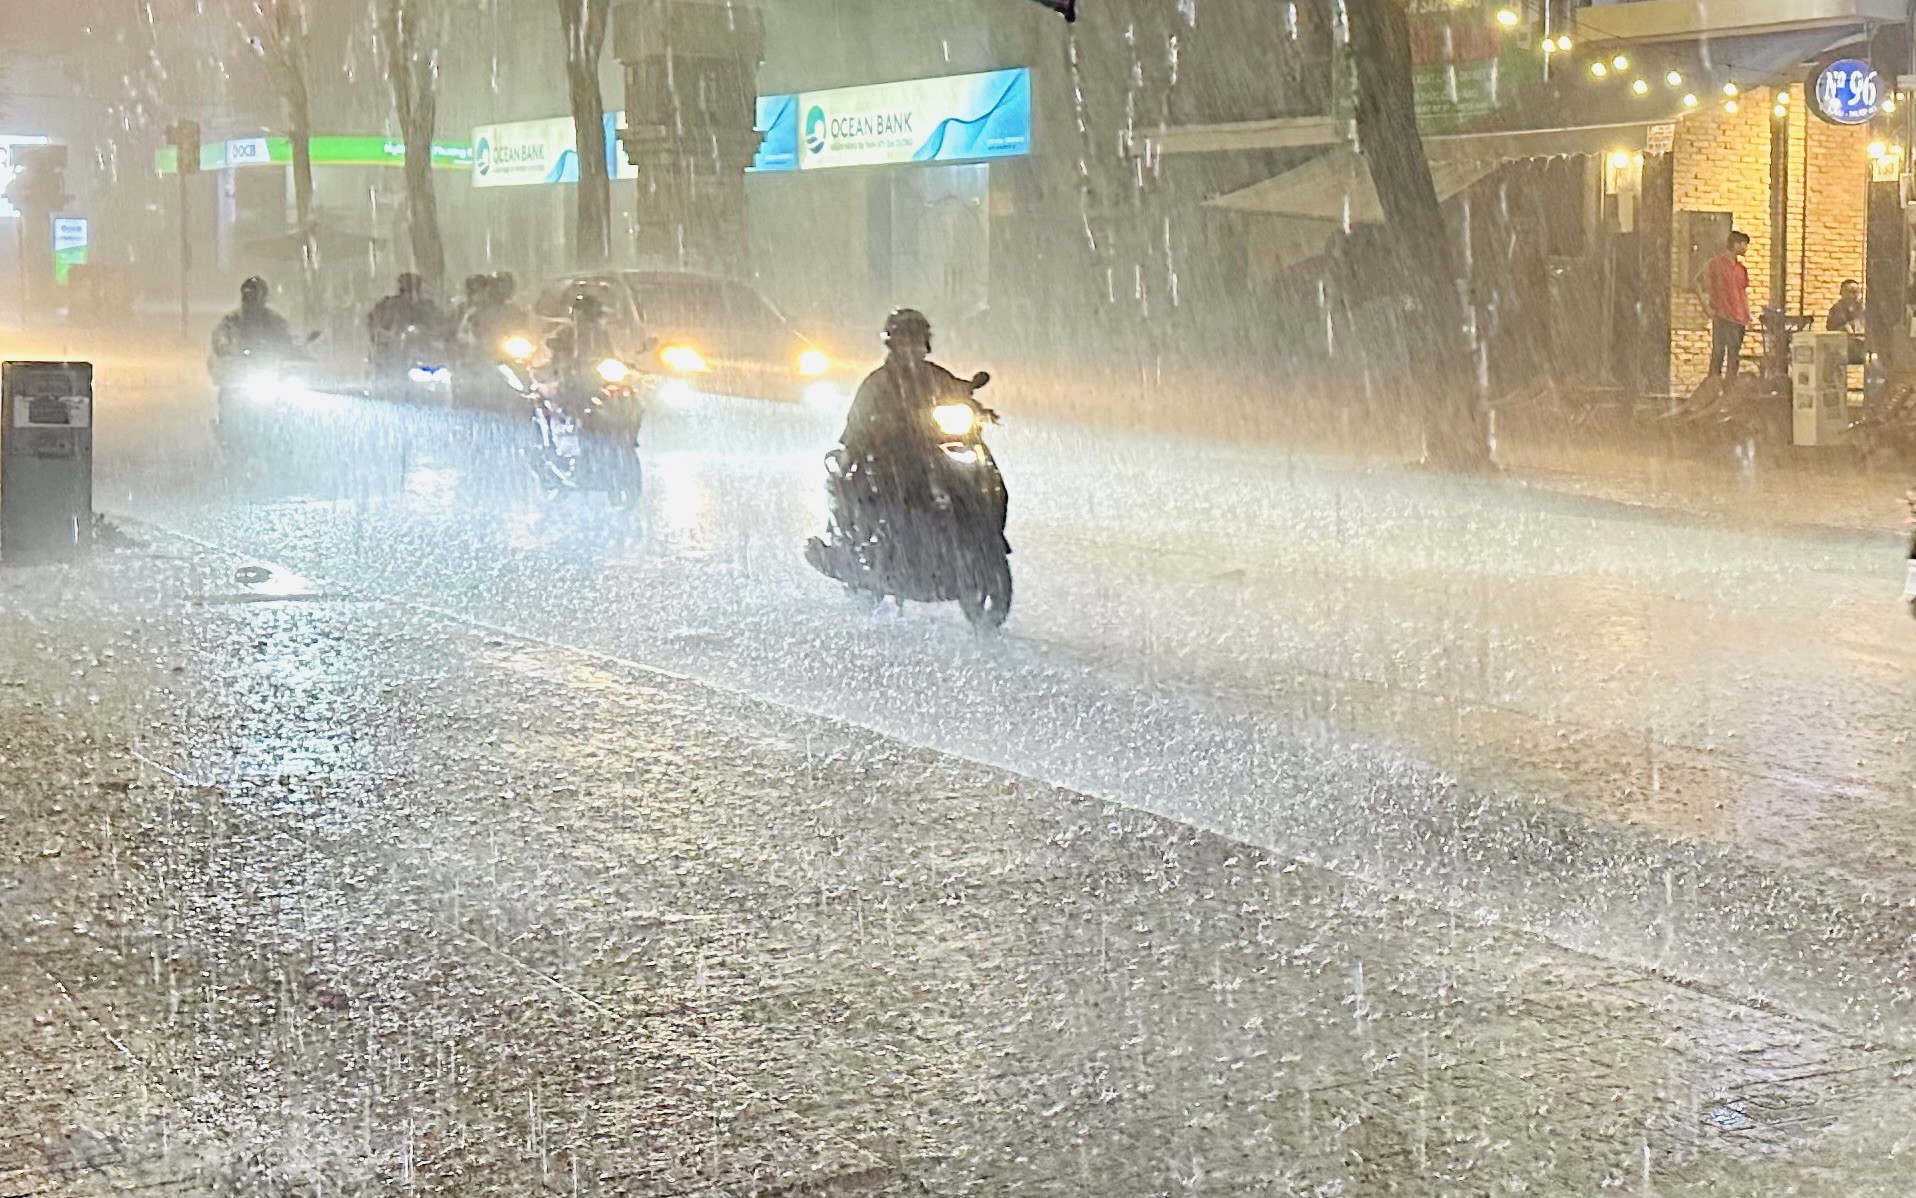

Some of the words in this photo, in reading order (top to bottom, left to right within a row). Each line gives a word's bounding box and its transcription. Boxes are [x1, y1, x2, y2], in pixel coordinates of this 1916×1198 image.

[1848, 70, 1877, 106] 96
[831, 116, 874, 139] OCEAN
[877, 111, 913, 135] BANK
[493, 145, 520, 164] OCEAN
[521, 143, 545, 162] BANK
